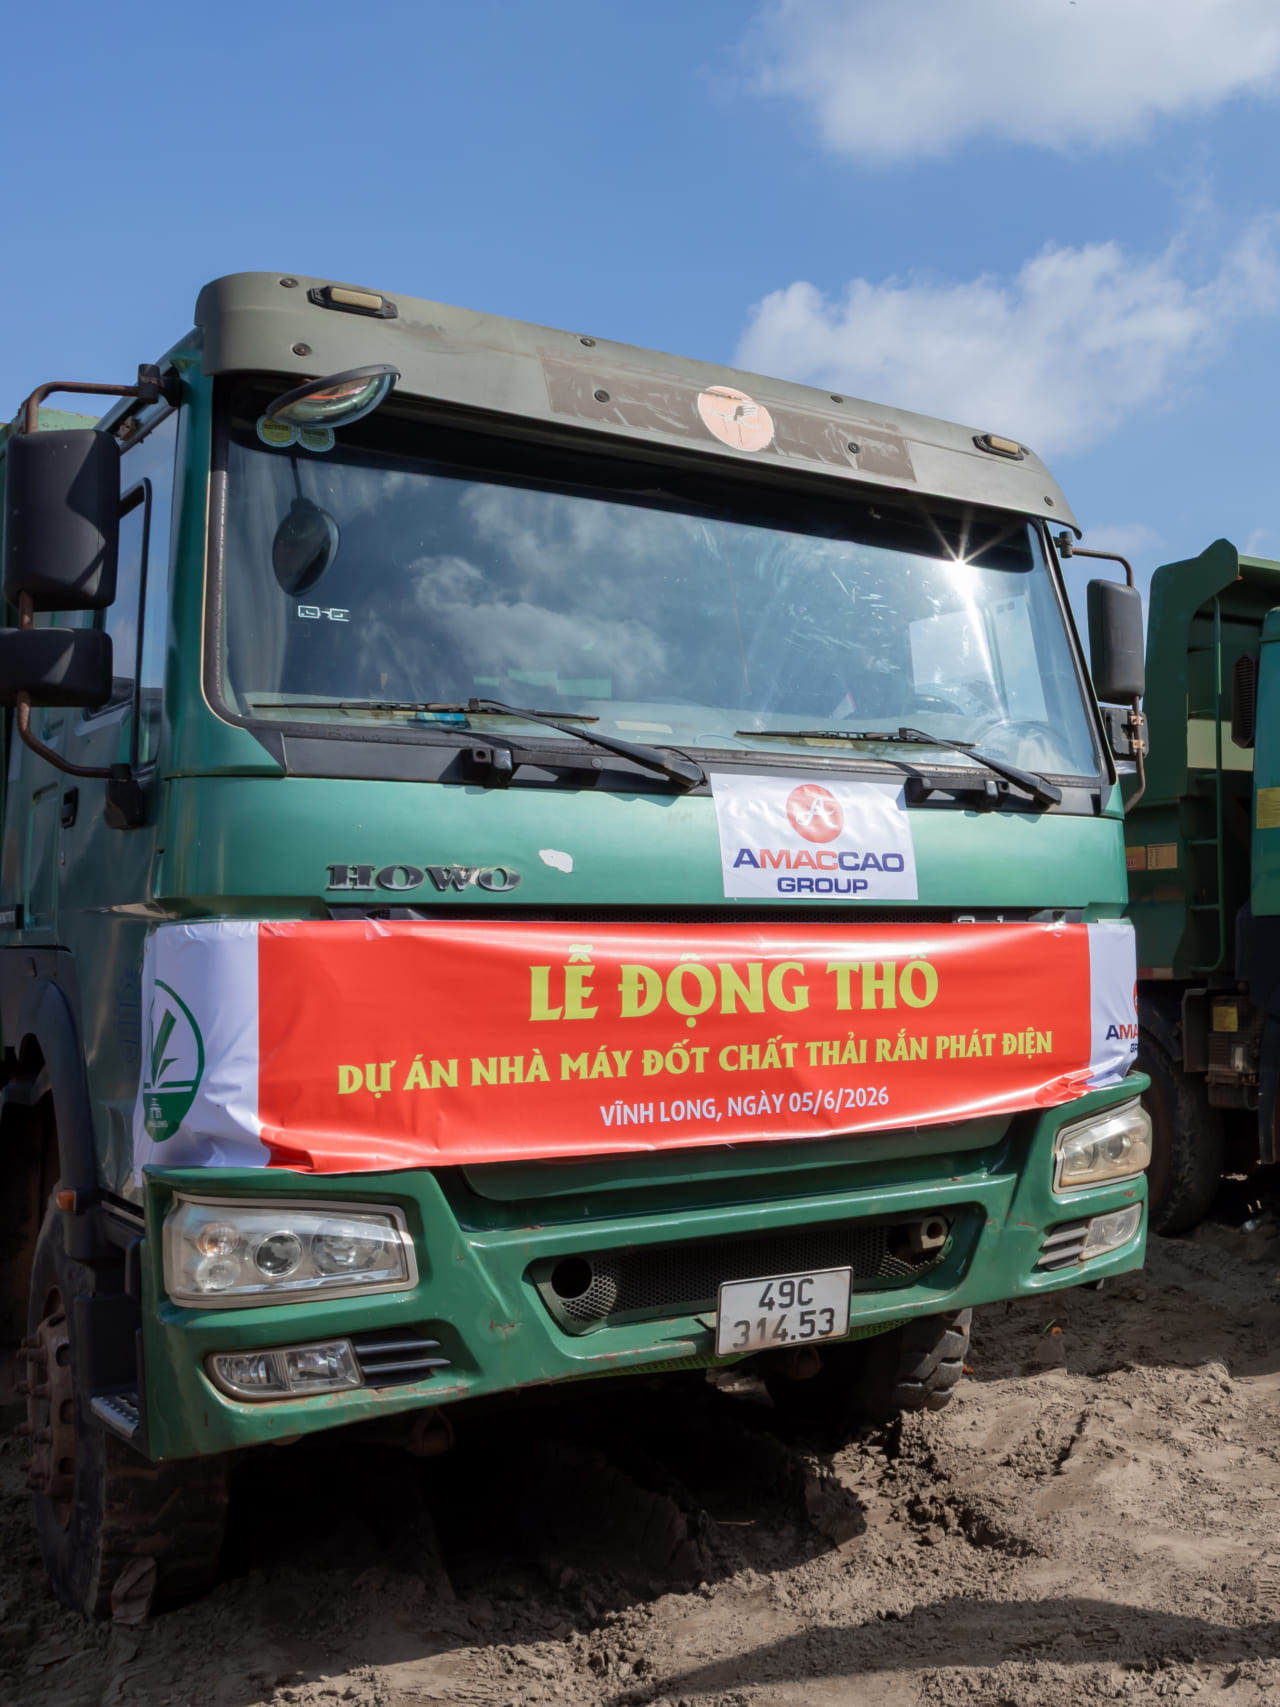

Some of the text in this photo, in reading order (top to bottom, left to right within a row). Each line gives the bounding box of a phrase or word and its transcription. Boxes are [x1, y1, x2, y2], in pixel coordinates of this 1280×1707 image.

[326, 864, 521, 892] HOWO
[733, 848, 905, 873] AMACCAO
[777, 877, 868, 894] GROUP
[529, 944, 599, 1021] LỄ
[618, 952, 810, 1028] ĐỘNG
[337, 1027, 1053, 1099] DỰ ÁN NHÀ MÁY ĐỐT CHẤT THẢI RẮN PHÁT ĐIỆN
[600, 1086, 889, 1126] VĨNH LONG, NGÀY 05/6/2026
[758, 1278, 814, 1311] 49C
[732, 1307, 835, 1349] 314.53
